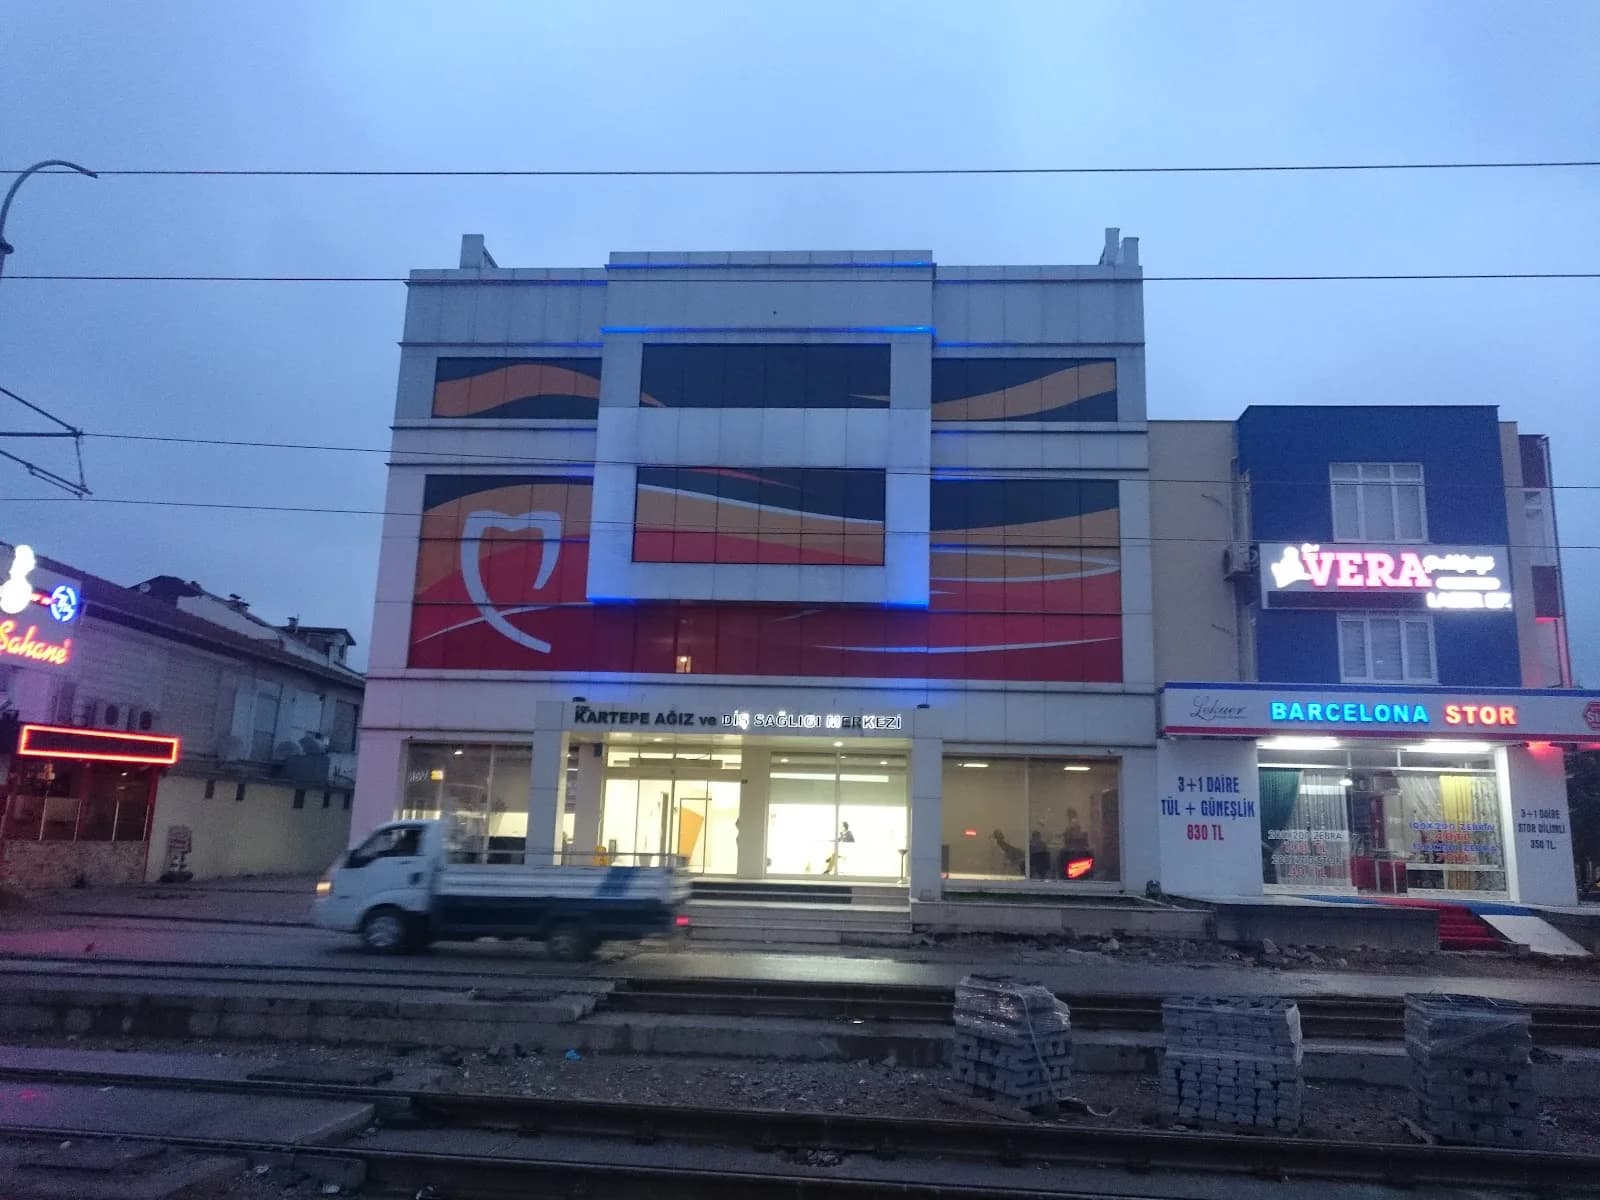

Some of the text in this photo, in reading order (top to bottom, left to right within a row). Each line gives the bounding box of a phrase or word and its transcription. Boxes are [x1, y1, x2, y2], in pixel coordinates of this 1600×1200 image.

[1303, 551, 1432, 588] VERA
[575, 710, 650, 725] KARTEPE
[655, 709, 694, 726] AĞIZ
[699, 716, 717, 727] ve
[826, 714, 902, 730] MERKEZİ
[1270, 701, 1518, 725] BARCELONA STOR
[1178, 774, 1240, 793] 3+1 DAİRE
[1161, 796, 1181, 816] TÜL
[1201, 797, 1255, 820] GÜNEŞLİK
[1211, 824, 1225, 841] TL
